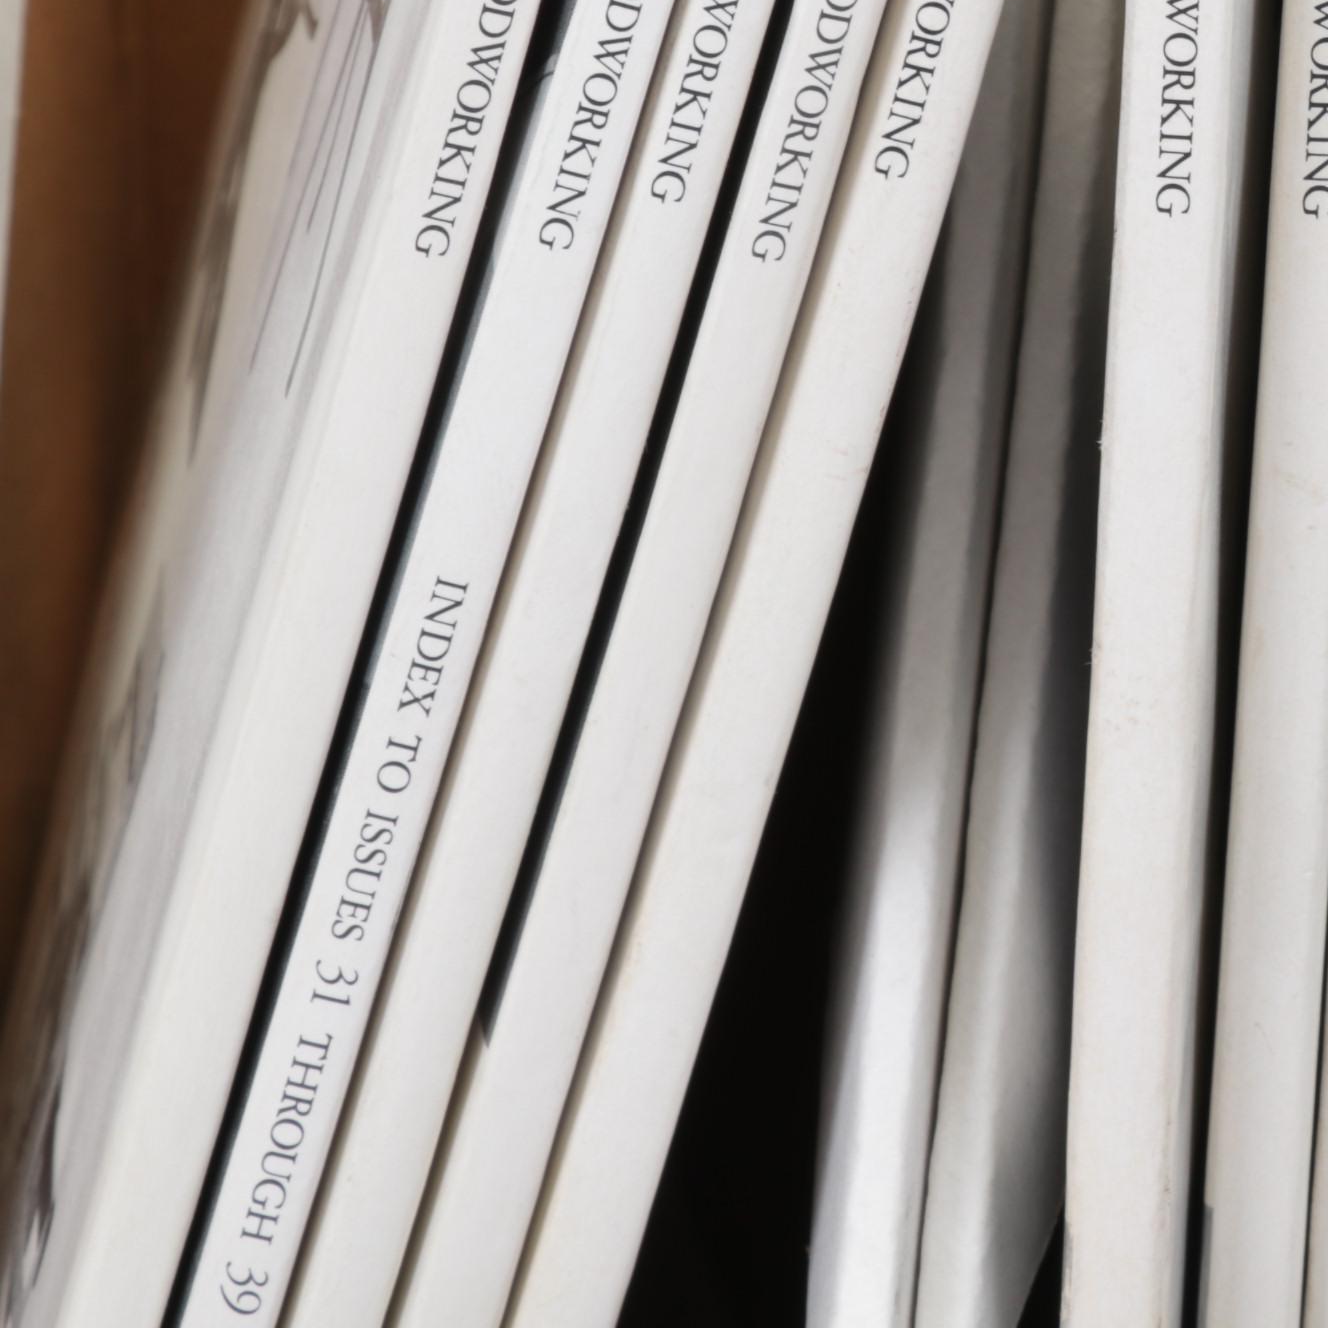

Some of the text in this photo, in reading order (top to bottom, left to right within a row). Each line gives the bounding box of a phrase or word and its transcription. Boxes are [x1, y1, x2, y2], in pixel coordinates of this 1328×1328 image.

[221, 576, 468, 1315] INDEX TO ISSUES 31 THROUGH 39
